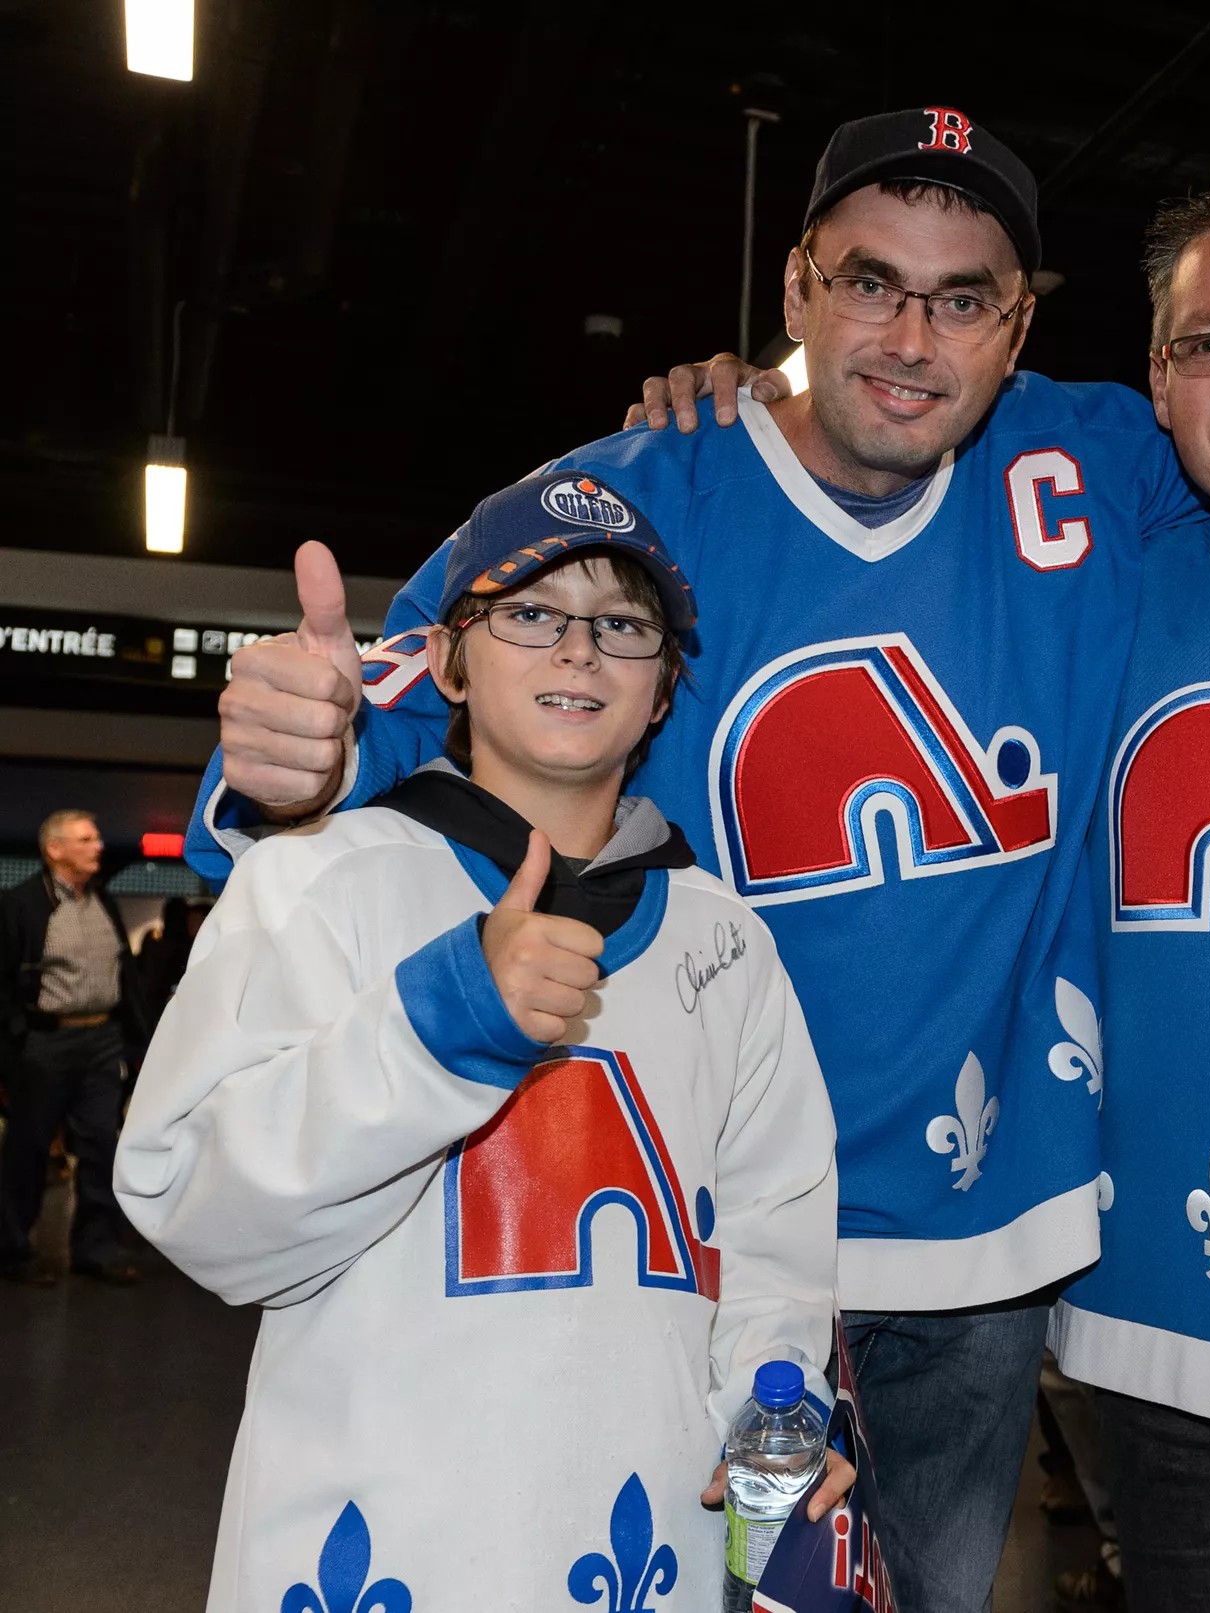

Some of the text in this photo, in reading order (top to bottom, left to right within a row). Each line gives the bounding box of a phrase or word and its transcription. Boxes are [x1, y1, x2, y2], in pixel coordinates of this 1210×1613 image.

[917, 106, 973, 154] B
[554, 492, 624, 525] OILERS
[1003, 446, 1094, 572] C
